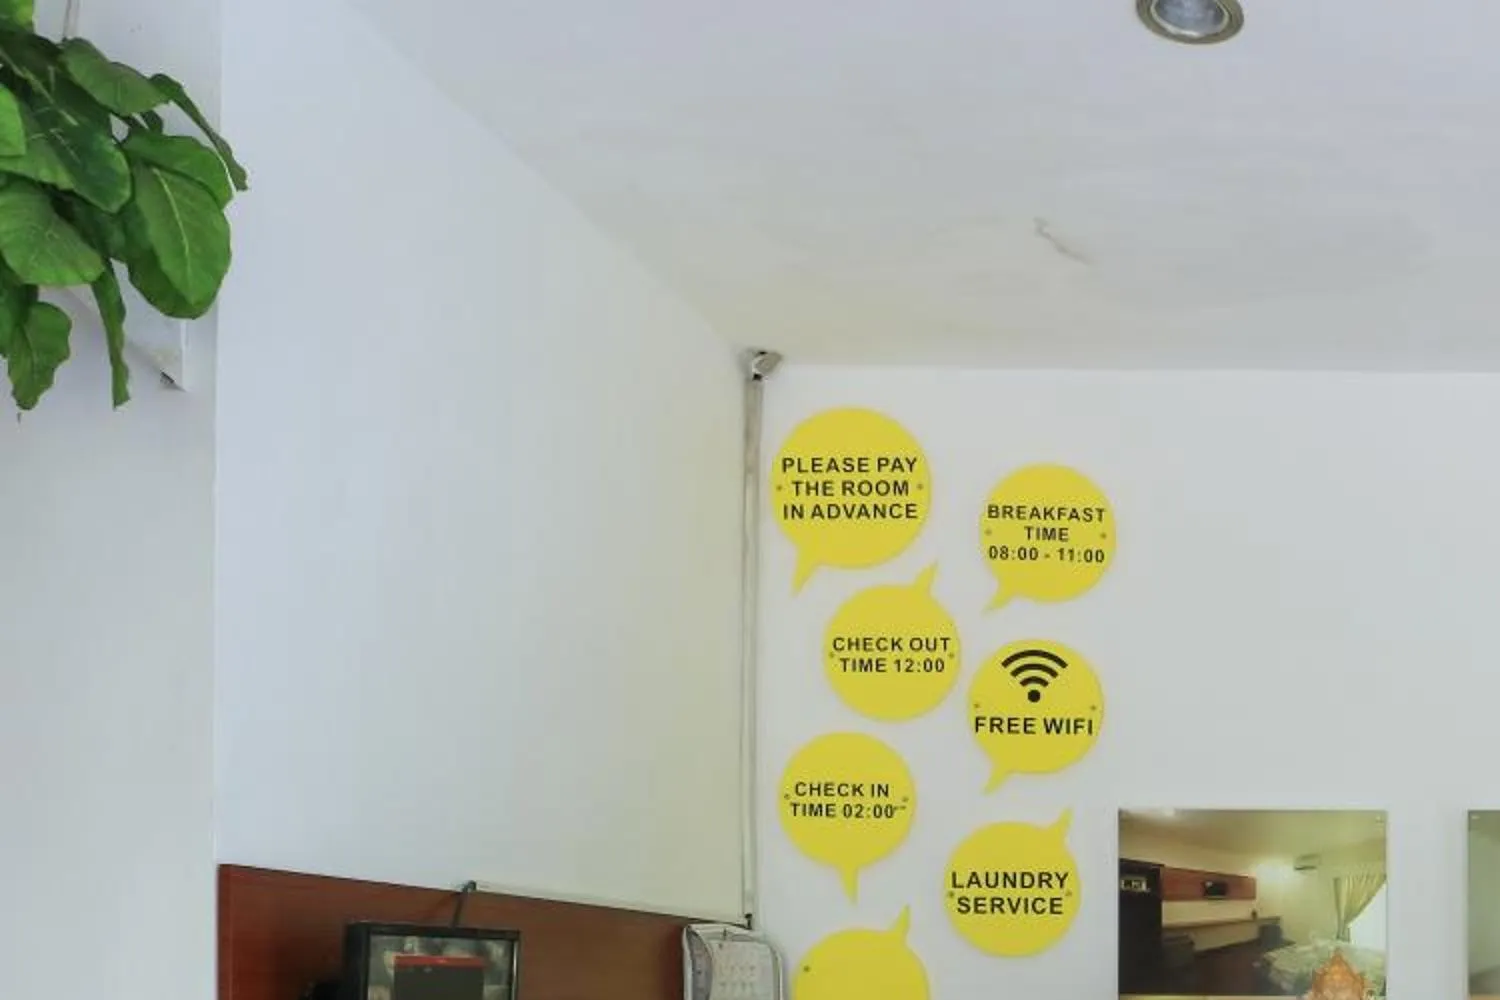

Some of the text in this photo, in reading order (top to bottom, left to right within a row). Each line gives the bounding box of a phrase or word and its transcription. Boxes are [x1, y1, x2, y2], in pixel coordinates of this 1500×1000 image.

[781, 456, 918, 474] PLEASE PAY
[791, 479, 909, 497] THE ROOM
[783, 502, 918, 520] IN ADVANCE
[987, 504, 1105, 523] BREAKFAST
[1023, 525, 1070, 543] TIME
[988, 545, 1039, 562] 08:00
[1057, 547, 1105, 564] 11:00
[832, 636, 951, 653] CHECK OUT
[839, 657, 945, 673] TIME 12:00
[974, 716, 1093, 736] FREE WIFI
[794, 781, 890, 798] CHECK IN
[789, 802, 895, 819] TIME 02:00
[951, 871, 1069, 889] LAUNDRY
[957, 896, 1063, 915] SERVICE
